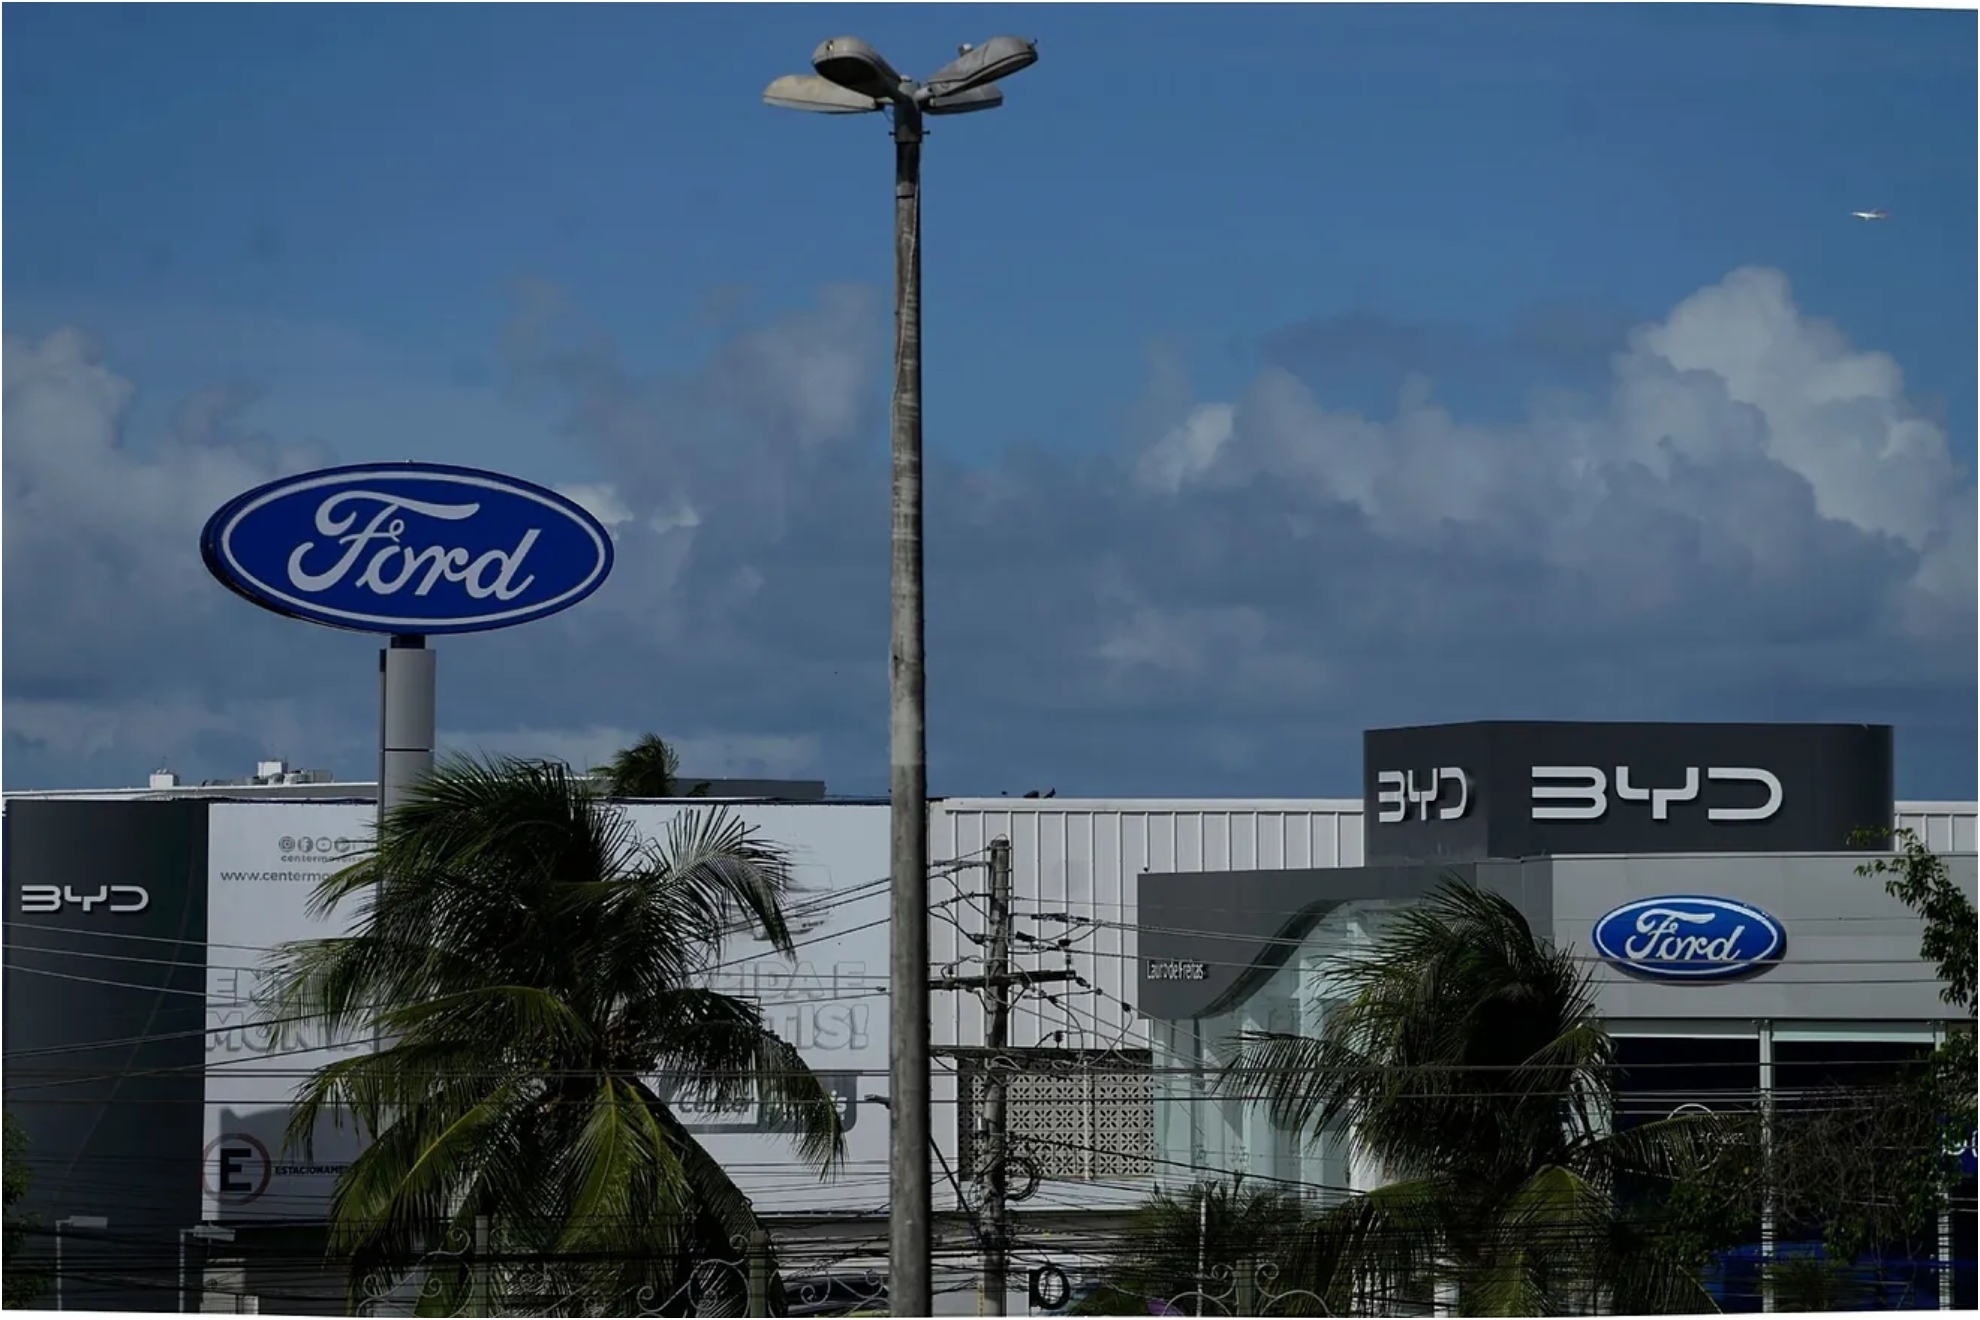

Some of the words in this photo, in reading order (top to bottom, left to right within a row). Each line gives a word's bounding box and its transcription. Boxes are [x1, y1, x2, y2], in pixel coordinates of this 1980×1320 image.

[288, 490, 541, 600] Ford
[1378, 766, 1468, 822] BYD
[1531, 766, 1783, 819] BYD
[21, 885, 149, 912] BYD
[1625, 908, 1744, 962] Ford
[764, 1004, 870, 1050] TIS!
[220, 1148, 252, 1191] E
